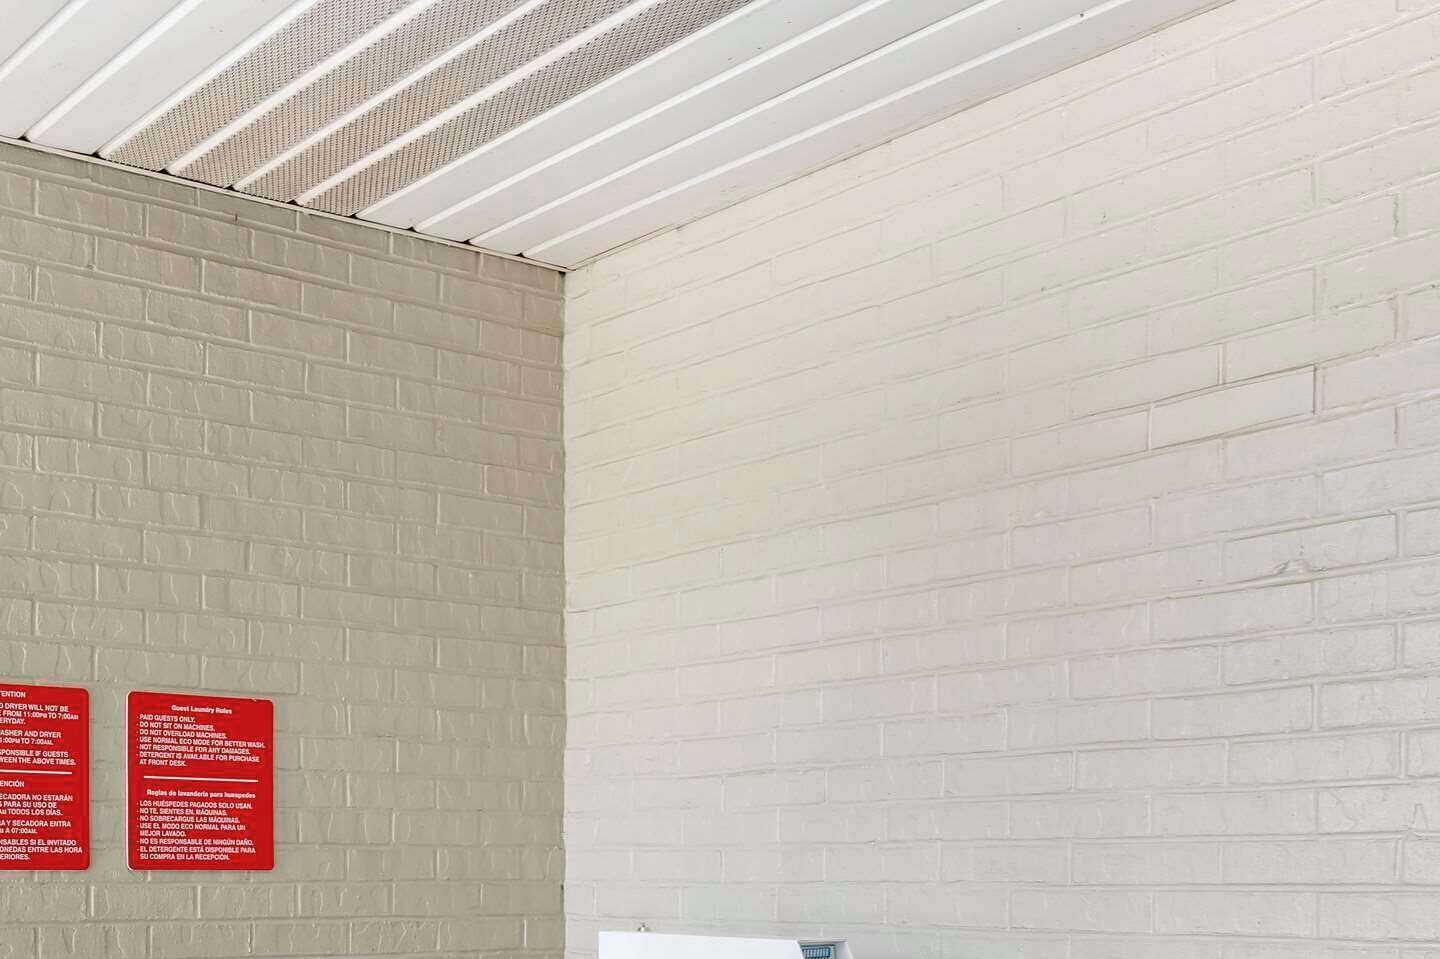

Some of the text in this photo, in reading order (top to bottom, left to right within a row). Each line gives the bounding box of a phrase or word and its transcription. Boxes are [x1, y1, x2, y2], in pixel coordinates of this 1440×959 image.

[4, 702, 27, 710] DRYER
[2, 709, 21, 717] FROM
[39, 730, 61, 738] DRYER
[43, 793, 72, 801] ESTARÁN
